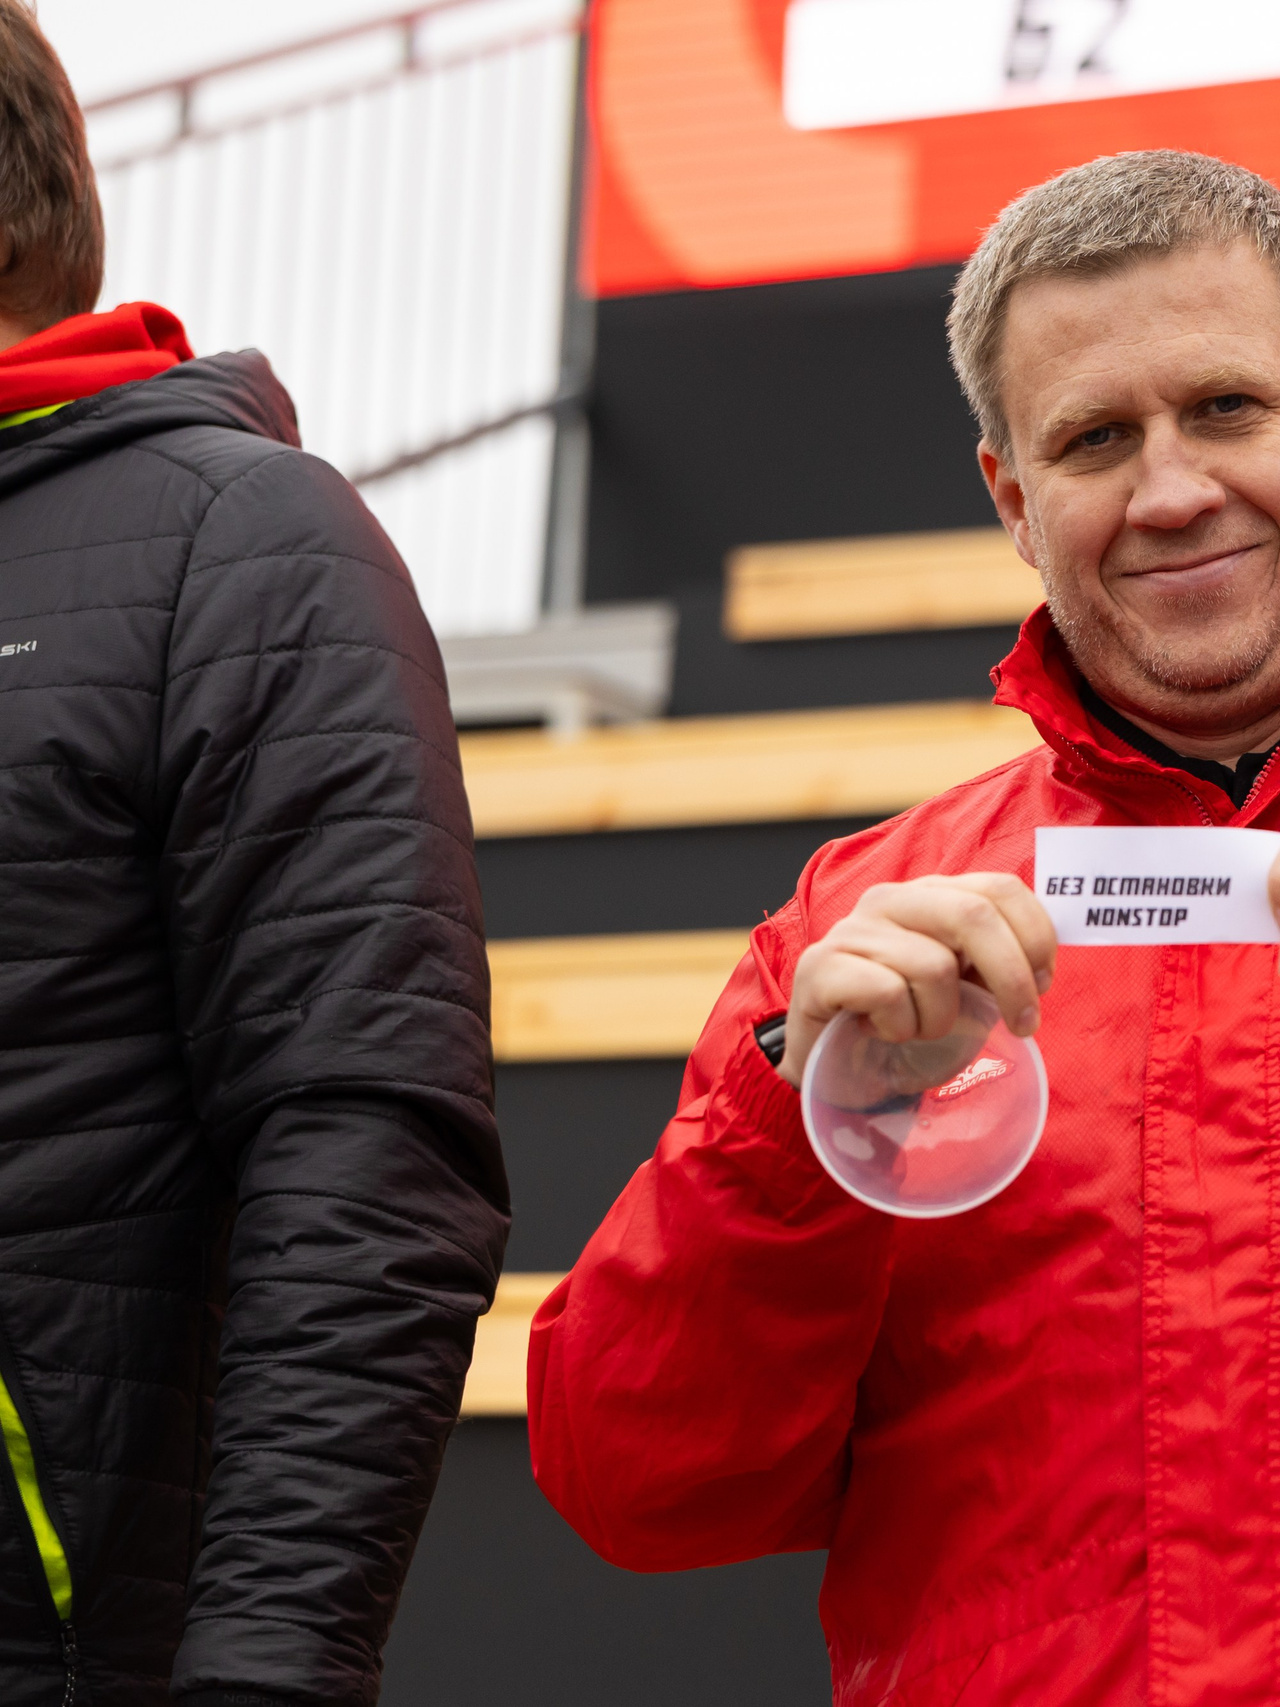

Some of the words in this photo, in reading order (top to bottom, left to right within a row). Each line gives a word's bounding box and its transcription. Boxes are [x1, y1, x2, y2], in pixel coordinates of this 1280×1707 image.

[0, 640, 38, 657] SKI
[1046, 877, 1084, 896] БЕЗ
[1092, 876, 1231, 896] ОСТАНОВКИ
[1086, 907, 1188, 927] NONSTOP
[938, 1066, 1007, 1097] FORWARD
